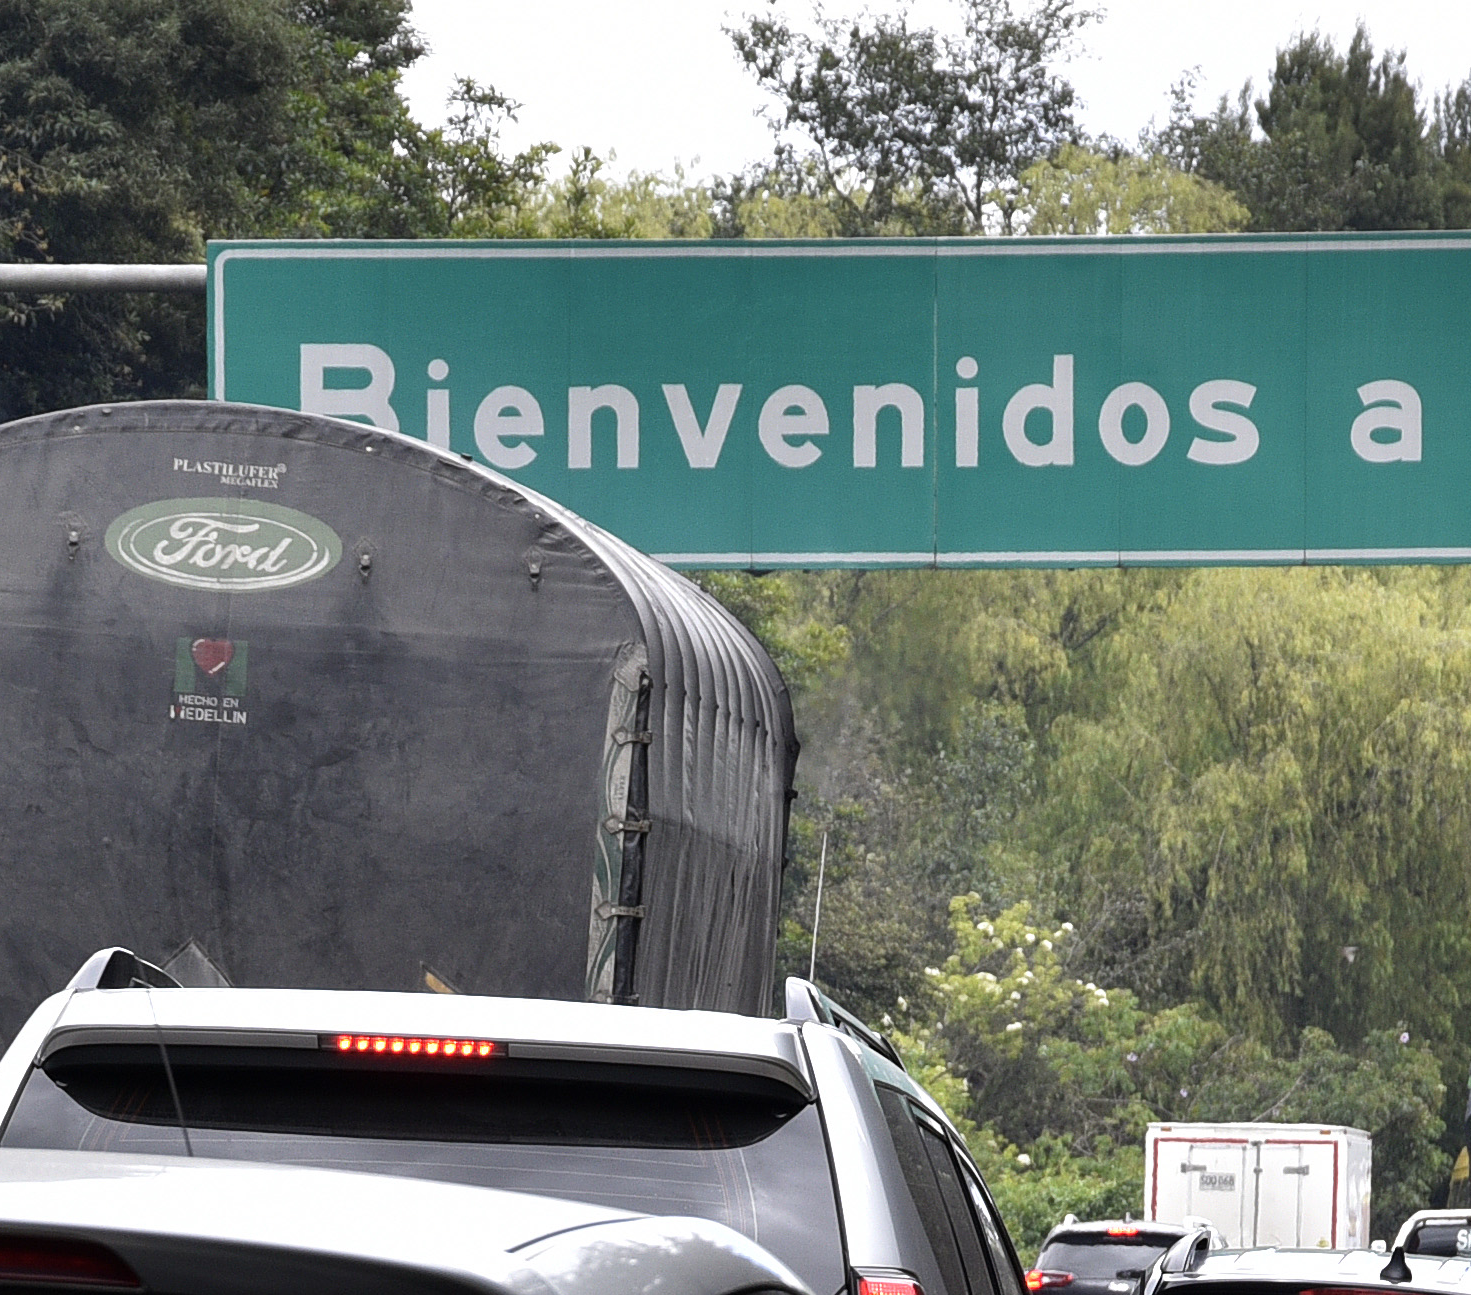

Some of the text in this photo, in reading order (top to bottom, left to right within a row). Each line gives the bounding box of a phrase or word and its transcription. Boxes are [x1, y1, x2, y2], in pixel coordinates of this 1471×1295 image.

[299, 341, 1260, 470] Bienvenidos
[1349, 378, 1424, 464] a
[153, 517, 294, 573] Ford
[178, 694, 240, 708] HECHO EN
